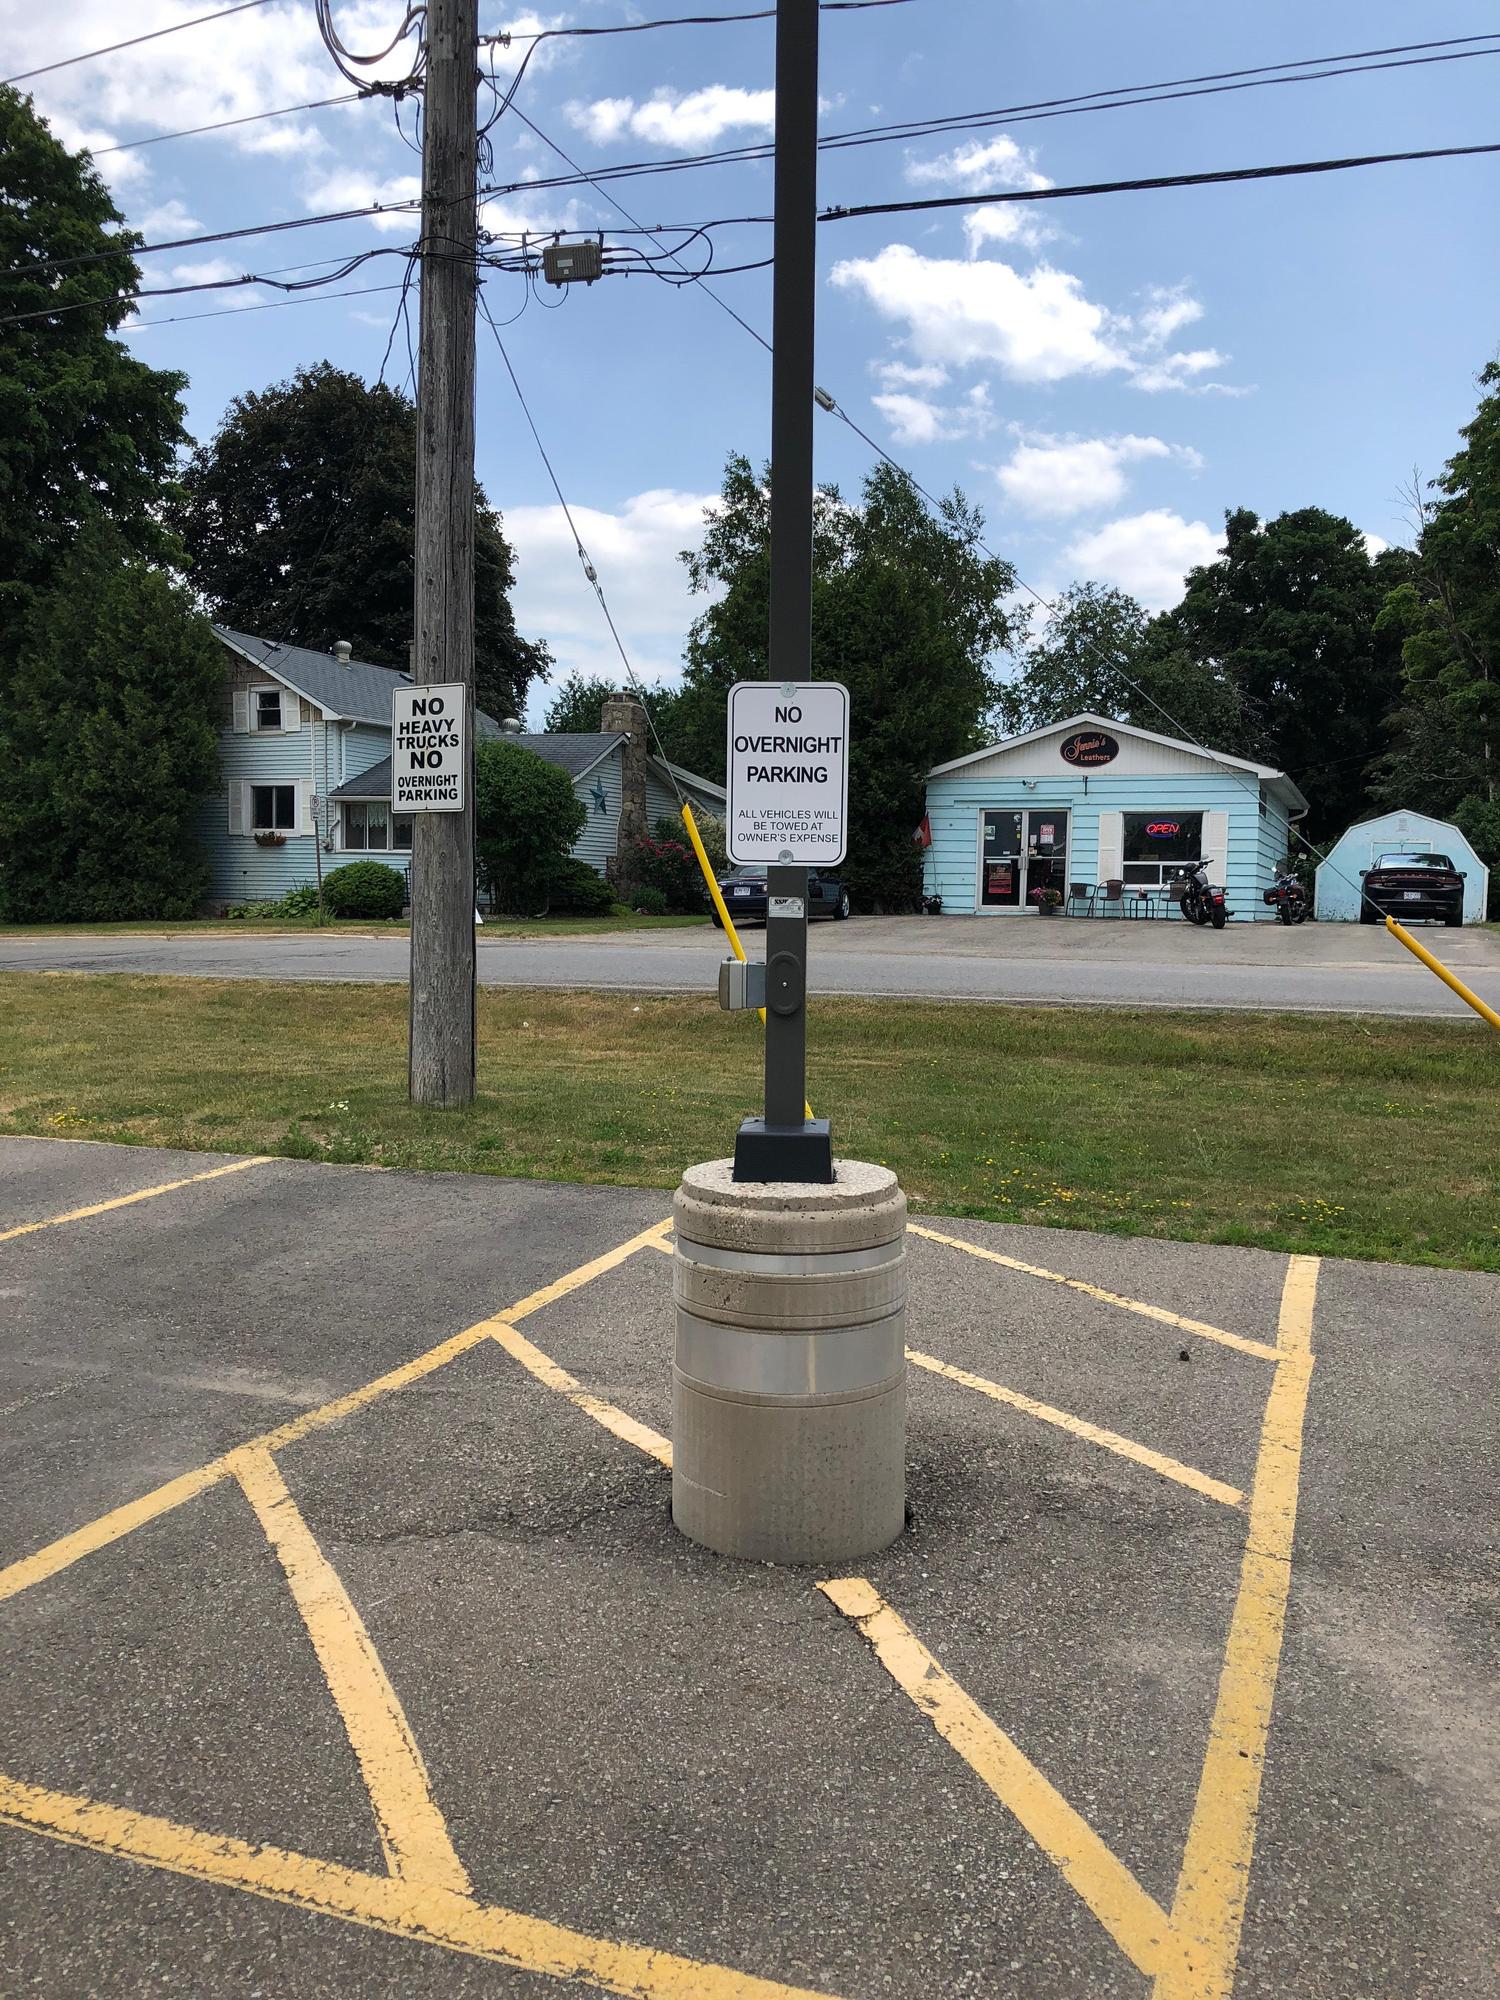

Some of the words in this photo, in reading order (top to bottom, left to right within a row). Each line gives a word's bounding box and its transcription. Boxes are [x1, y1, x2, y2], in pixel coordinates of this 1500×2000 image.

[412, 698, 444, 716] NO
[775, 706, 802, 723] NO
[400, 719, 455, 735] HEAVY
[396, 734, 459, 749] TRUCKS
[734, 736, 842, 753] OVERNIGHT
[410, 750, 443, 769] NO
[398, 774, 458, 788] OVERNIGHT
[747, 766, 828, 783] PARKING
[398, 788, 458, 801] PARKING
[738, 810, 757, 819] ALL
[760, 810, 811, 819] VEHICLES
[813, 810, 838, 820] WILL
[753, 821, 767, 830] BE
[770, 822, 808, 831] TOWED
[810, 822, 823, 831] AT
[1146, 824, 1180, 834] OPEN
[737, 833, 787, 842] OWNER'S
[789, 833, 838, 843] EXPENSE
